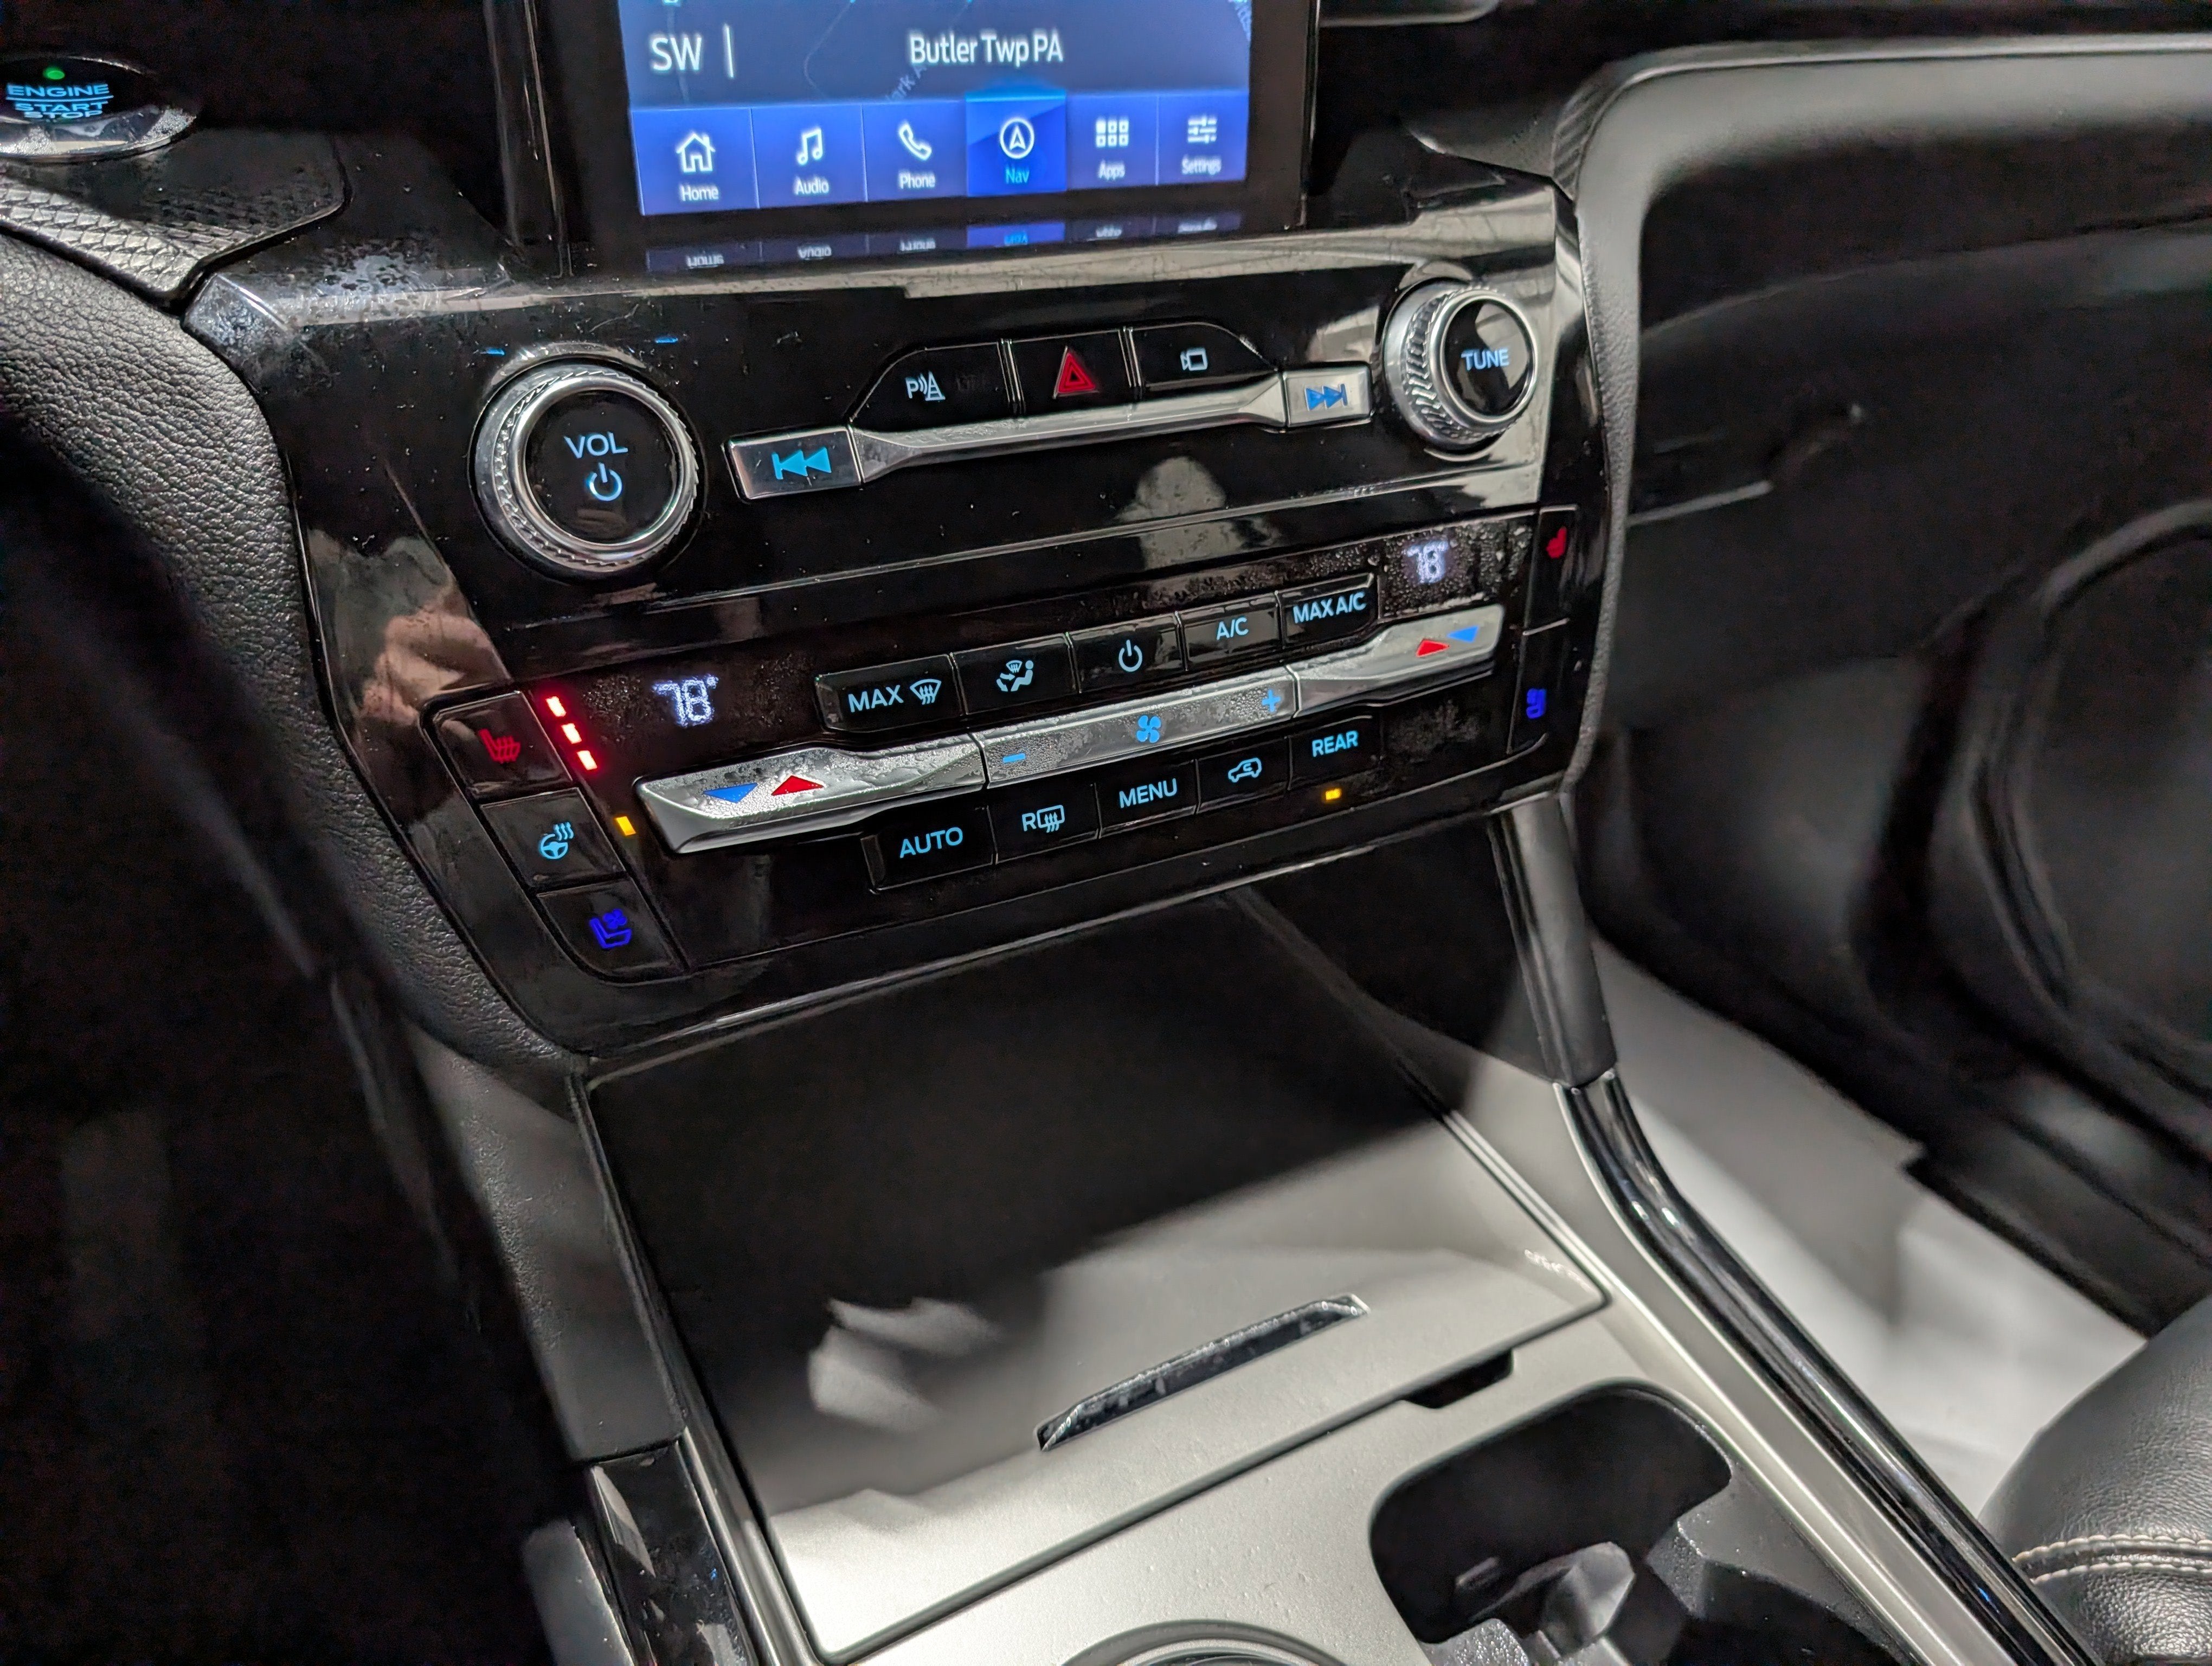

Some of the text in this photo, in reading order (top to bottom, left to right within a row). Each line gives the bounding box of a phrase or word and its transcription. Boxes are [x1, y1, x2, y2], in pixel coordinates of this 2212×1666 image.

[651, 36, 703, 71] SW
[908, 29, 1064, 68] Butler Twp PA
[6, 83, 110, 97] ENGINE
[15, 101, 108, 112] START
[24, 110, 103, 119] STOP
[1005, 164, 1030, 185] Nav
[1098, 159, 1126, 181] Apps
[1181, 156, 1222, 176] Settings
[794, 176, 829, 196] Audio
[898, 171, 936, 190] Phone
[679, 184, 719, 202] Home
[1461, 347, 1510, 371] TUNE
[563, 432, 628, 459] VOL
[1292, 591, 1367, 624] MAX A/C
[1215, 617, 1249, 640] A/C
[848, 684, 904, 713] MAX
[1311, 730, 1359, 758] REAR
[1118, 778, 1178, 809] MENU
[1021, 813, 1036, 832] R
[899, 826, 964, 858] AUTO
